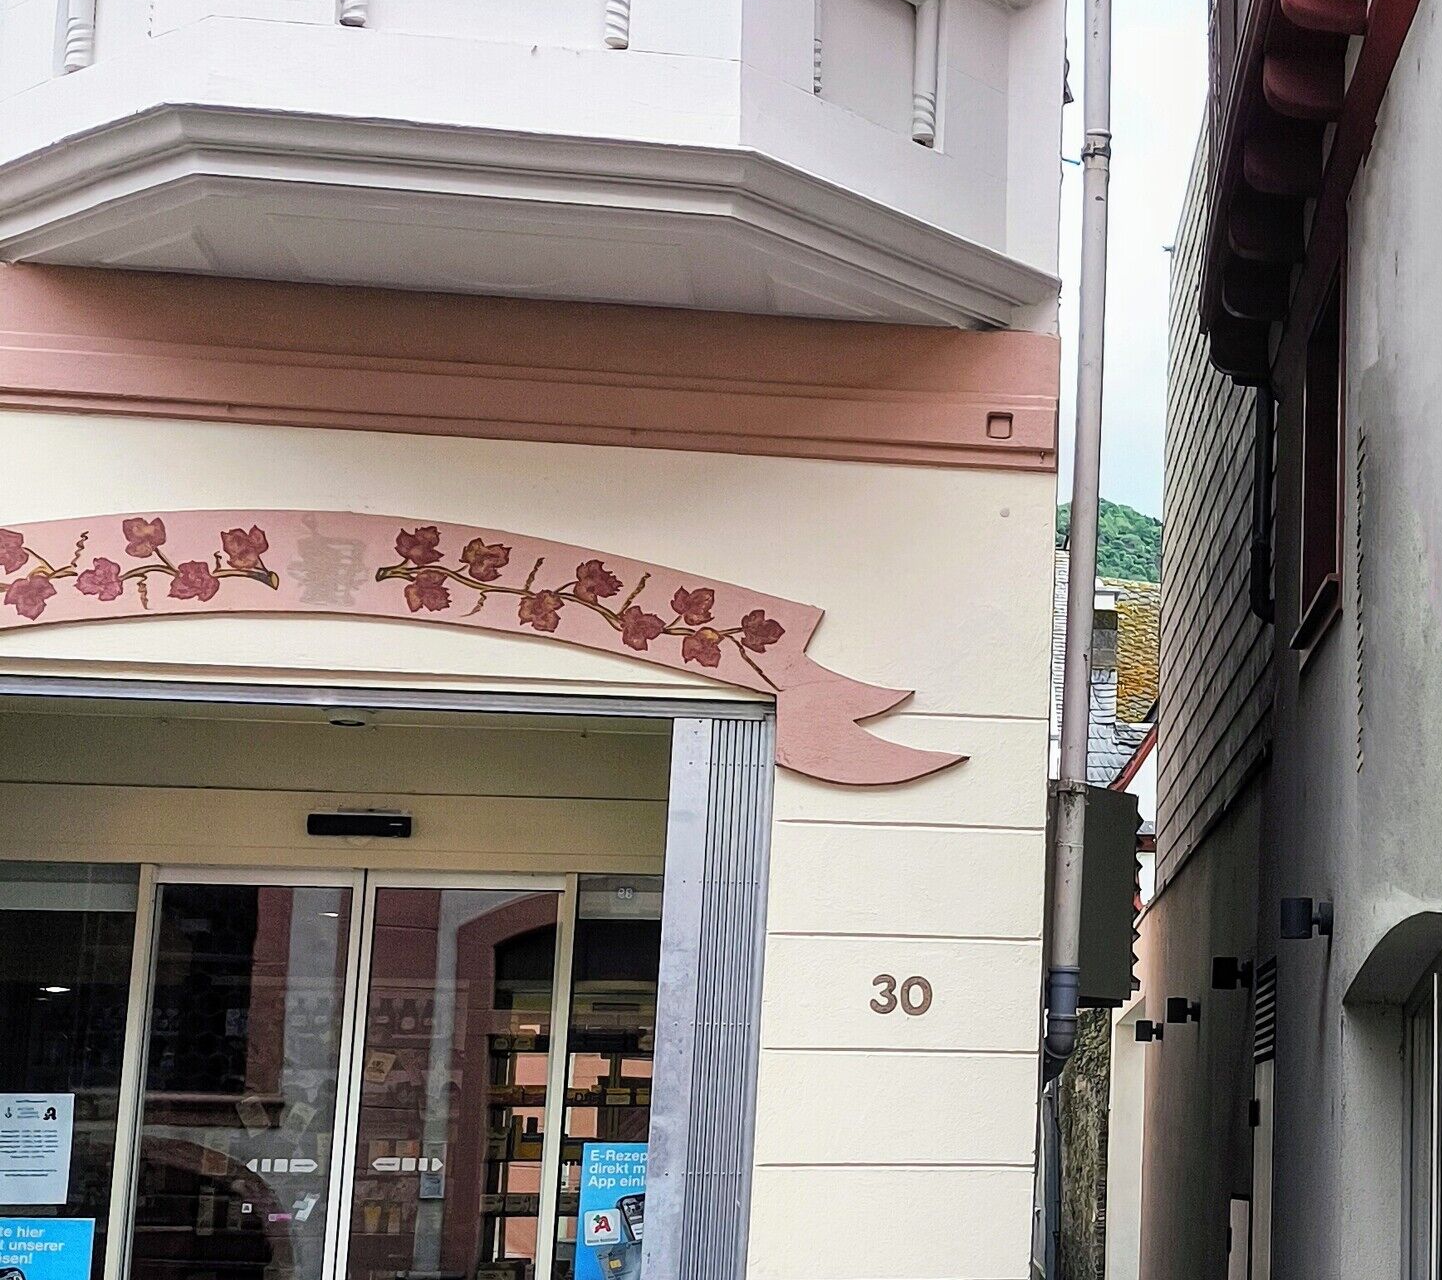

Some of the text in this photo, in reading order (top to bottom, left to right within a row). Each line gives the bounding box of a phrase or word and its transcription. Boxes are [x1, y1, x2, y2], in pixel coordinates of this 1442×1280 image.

[870, 974, 933, 1016] 30
[589, 1162, 629, 1174] direkt
[588, 1175, 616, 1189] App
[17, 1225, 45, 1238] hier
[8, 1241, 65, 1251] unserer
